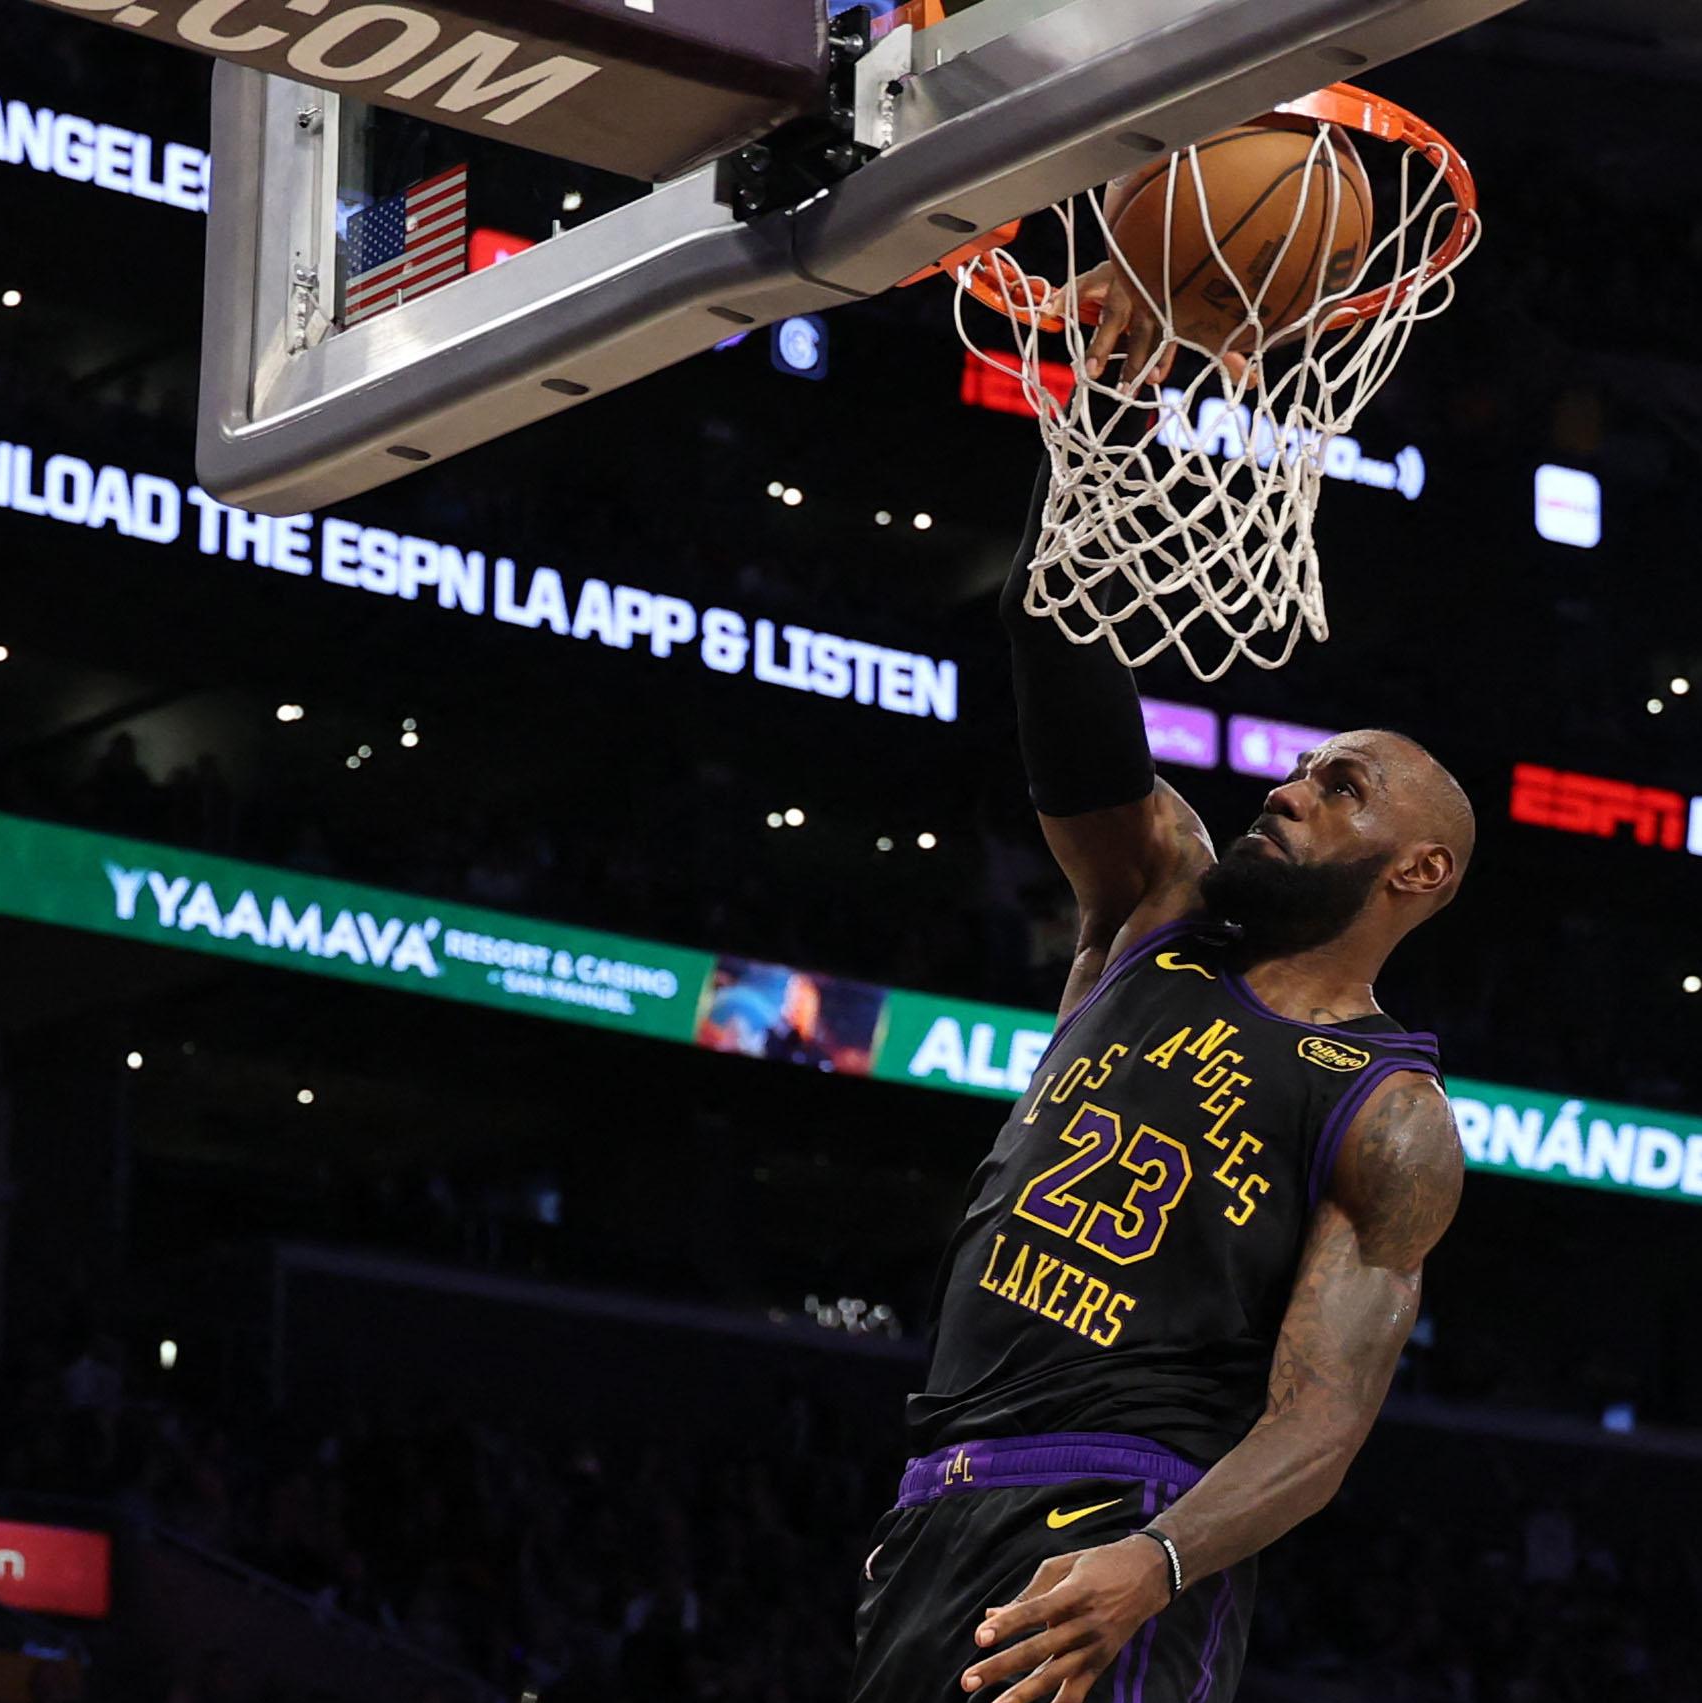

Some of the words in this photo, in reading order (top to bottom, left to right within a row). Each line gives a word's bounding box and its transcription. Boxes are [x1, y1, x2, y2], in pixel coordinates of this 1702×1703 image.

[188, 484, 313, 576] THE
[322, 519, 485, 617] ESPN
[495, 556, 571, 635] LA
[571, 577, 698, 658] APP
[700, 608, 751, 673] &
[754, 619, 959, 722] LISTEN
[1510, 761, 1686, 852] ESPN
[443, 928, 553, 975] RESORT
[576, 954, 679, 999] CASINO
[1307, 1040, 1363, 1068] bibigo
[1022, 1043, 1129, 1126] LOS
[1143, 1018, 1271, 1228] ANGELES
[1012, 1100, 1194, 1267] 23
[978, 1233, 1137, 1350] LAKERS
